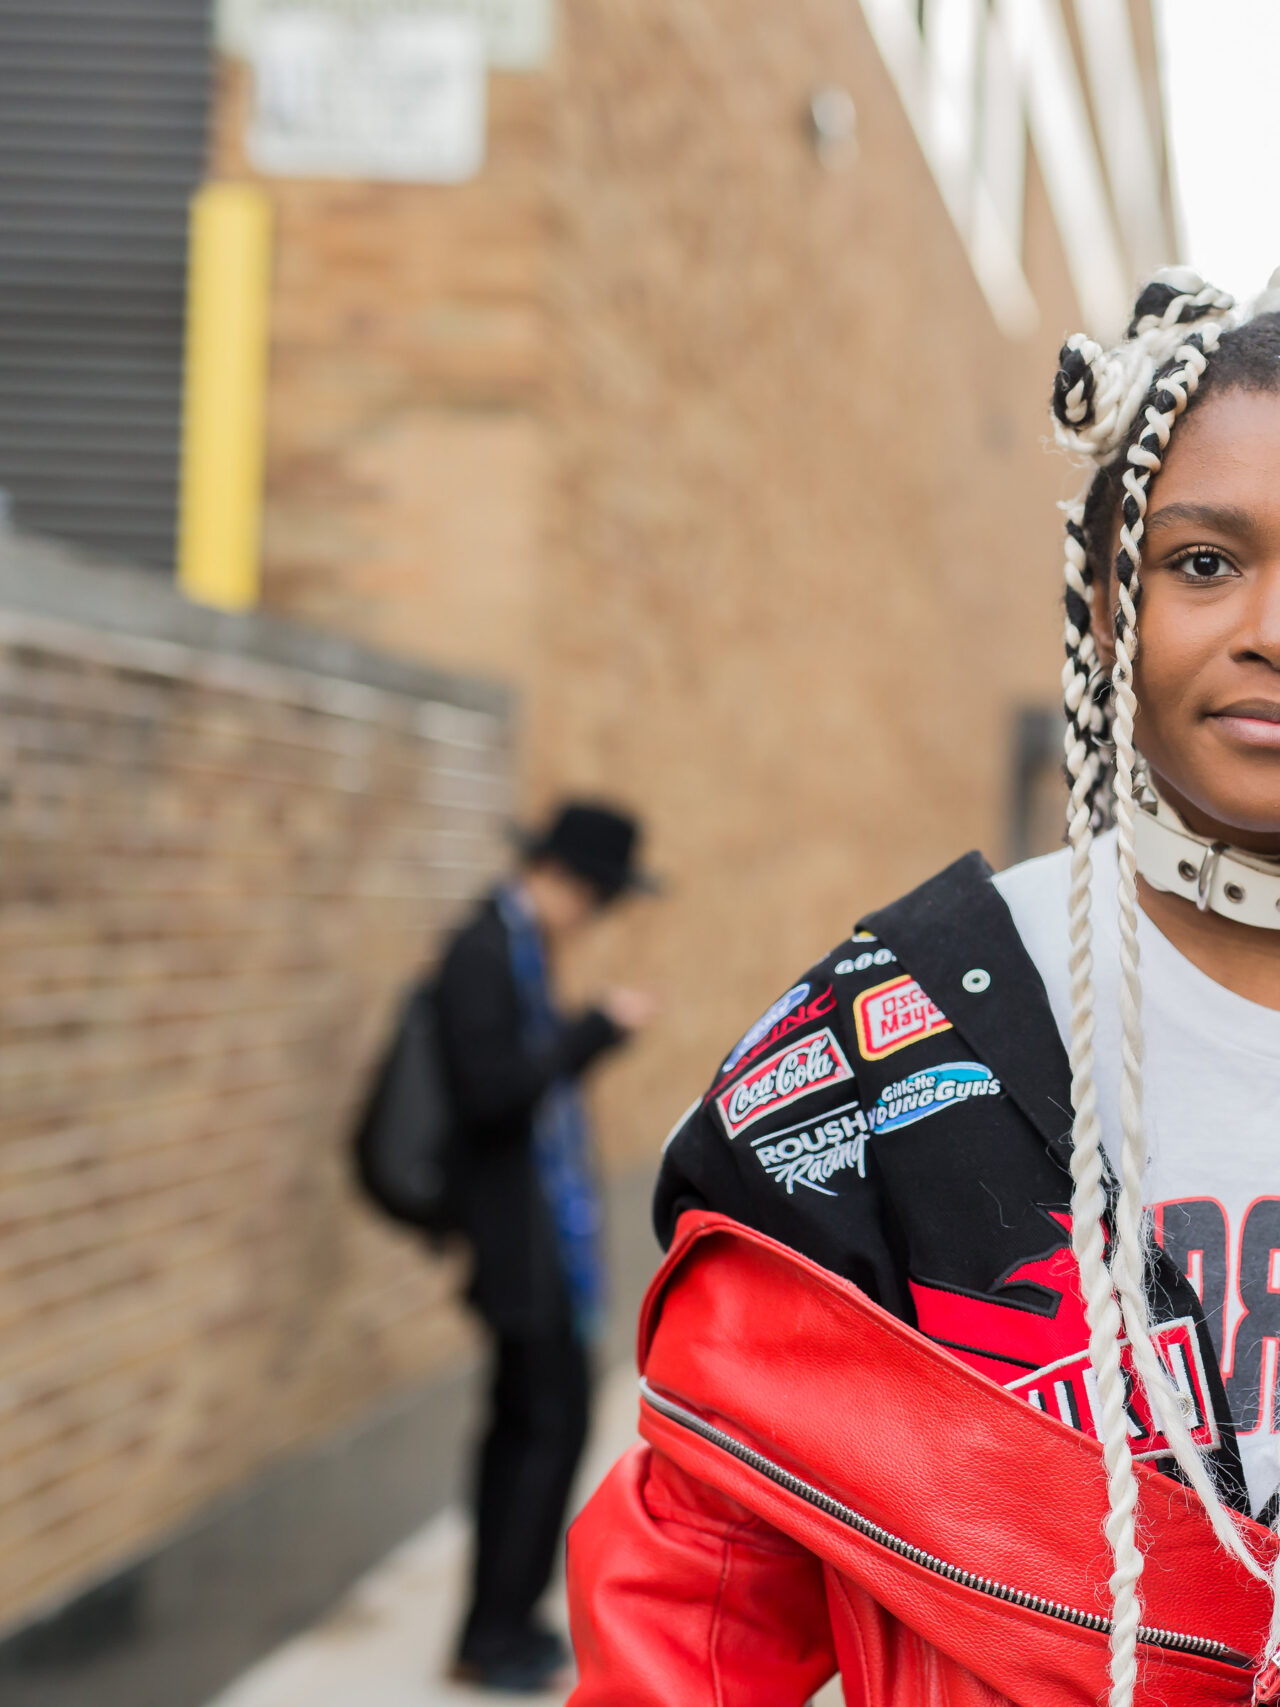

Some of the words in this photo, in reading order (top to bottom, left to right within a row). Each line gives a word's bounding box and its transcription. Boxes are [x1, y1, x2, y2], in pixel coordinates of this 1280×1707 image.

[880, 1001, 940, 1037] Maye
[881, 1074, 937, 1101] Gillette
[756, 1110, 868, 1167] ROUSH
[774, 1133, 871, 1196] Racing
